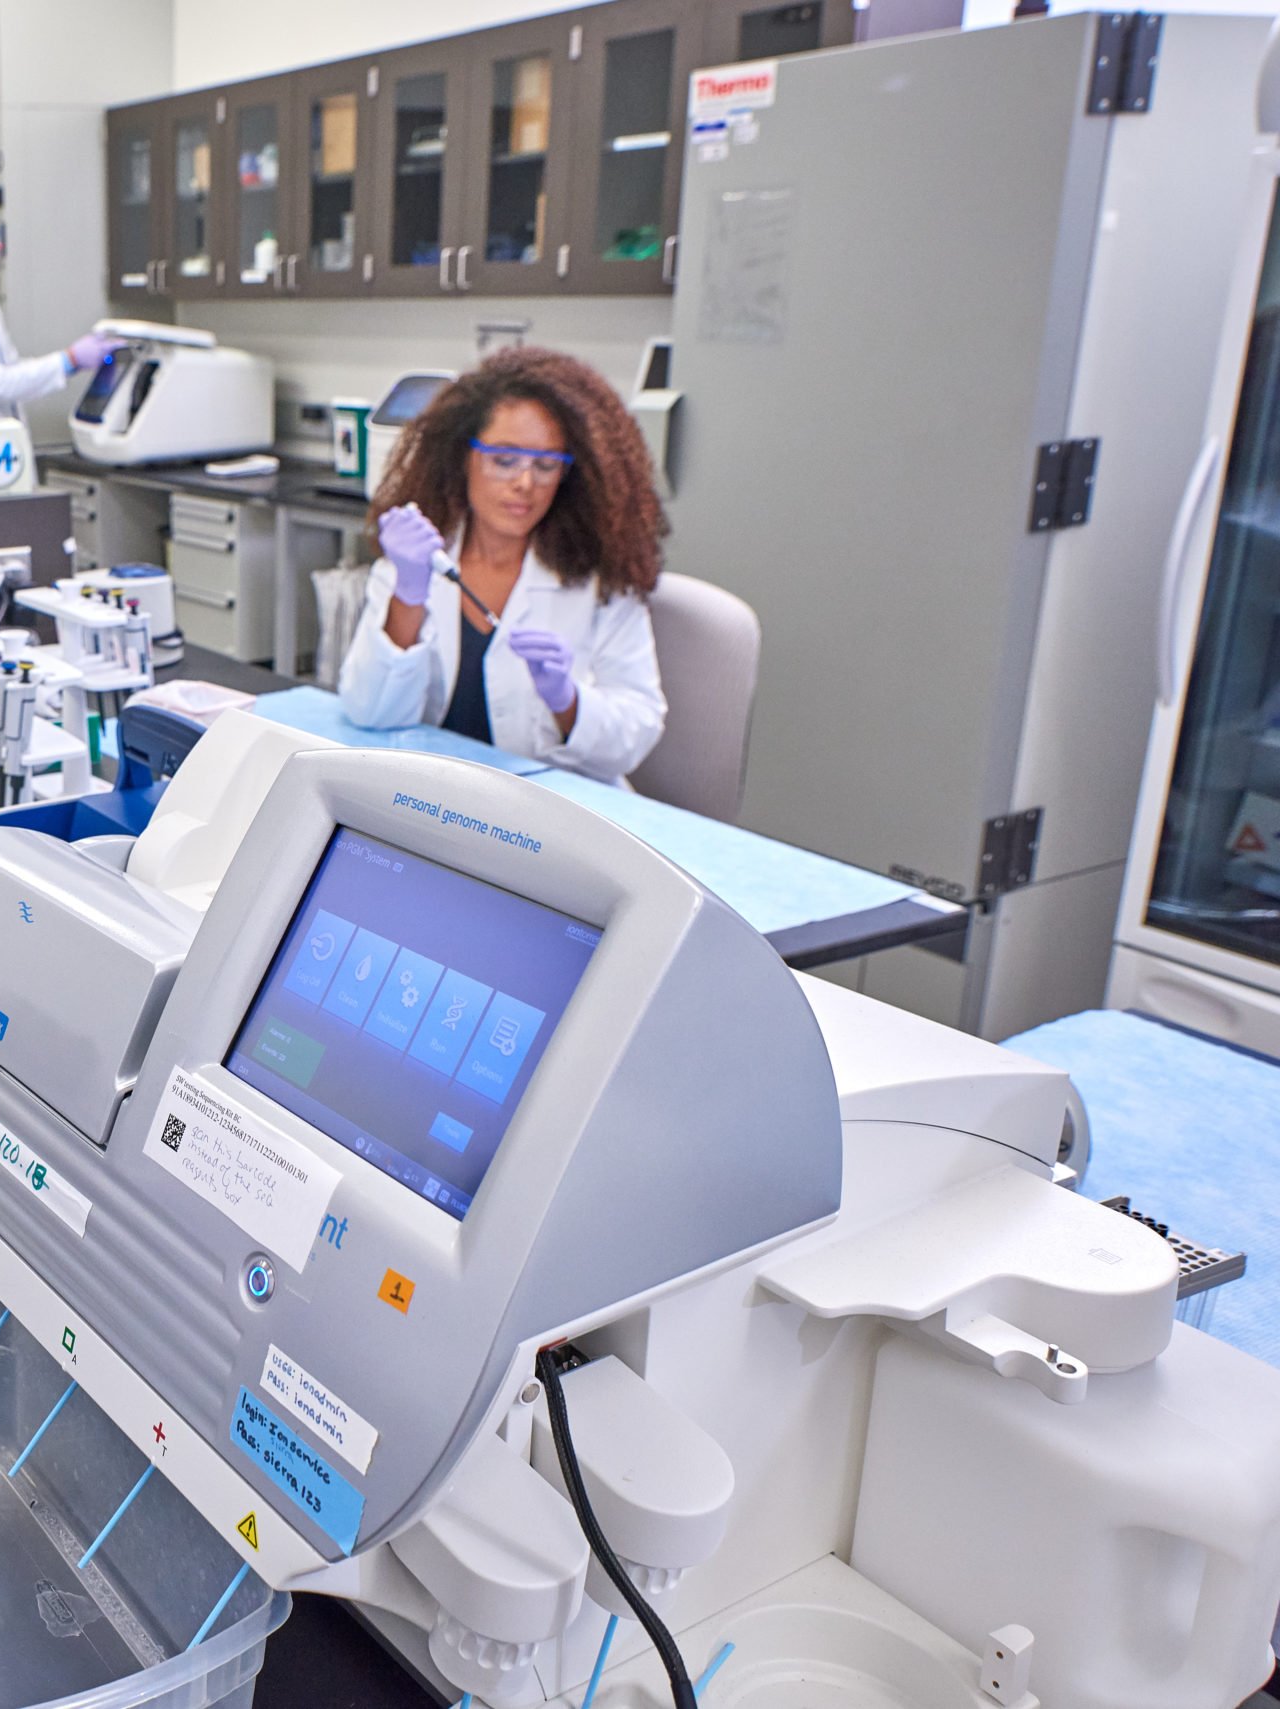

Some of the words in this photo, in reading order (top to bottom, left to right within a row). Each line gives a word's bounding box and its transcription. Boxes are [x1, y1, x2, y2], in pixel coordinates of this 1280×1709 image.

[697, 73, 770, 100] Thermo
[392, 791, 442, 819] personal
[441, 808, 489, 834] genome
[490, 825, 542, 853] machine
[430, 1037, 447, 1054] Run
[472, 1060, 503, 1084] Options
[183, 1080, 200, 1097] testing
[199, 1088, 227, 1115] Sequencing
[226, 1104, 235, 1118] Kit
[233, 1111, 242, 1124] BC
[188, 1140, 220, 1168] instead
[220, 1165, 231, 1188] of
[235, 1171, 251, 1193] the
[214, 1137, 232, 1160] this
[236, 1150, 277, 1191] barcode
[224, 1188, 242, 1206] box
[389, 1281, 405, 1303] 1
[71, 1354, 77, 1365] A
[241, 1392, 268, 1428] login:
[299, 1373, 348, 1422] ionadmin
[294, 1392, 344, 1444] ionadmin
[162, 1445, 169, 1457] T
